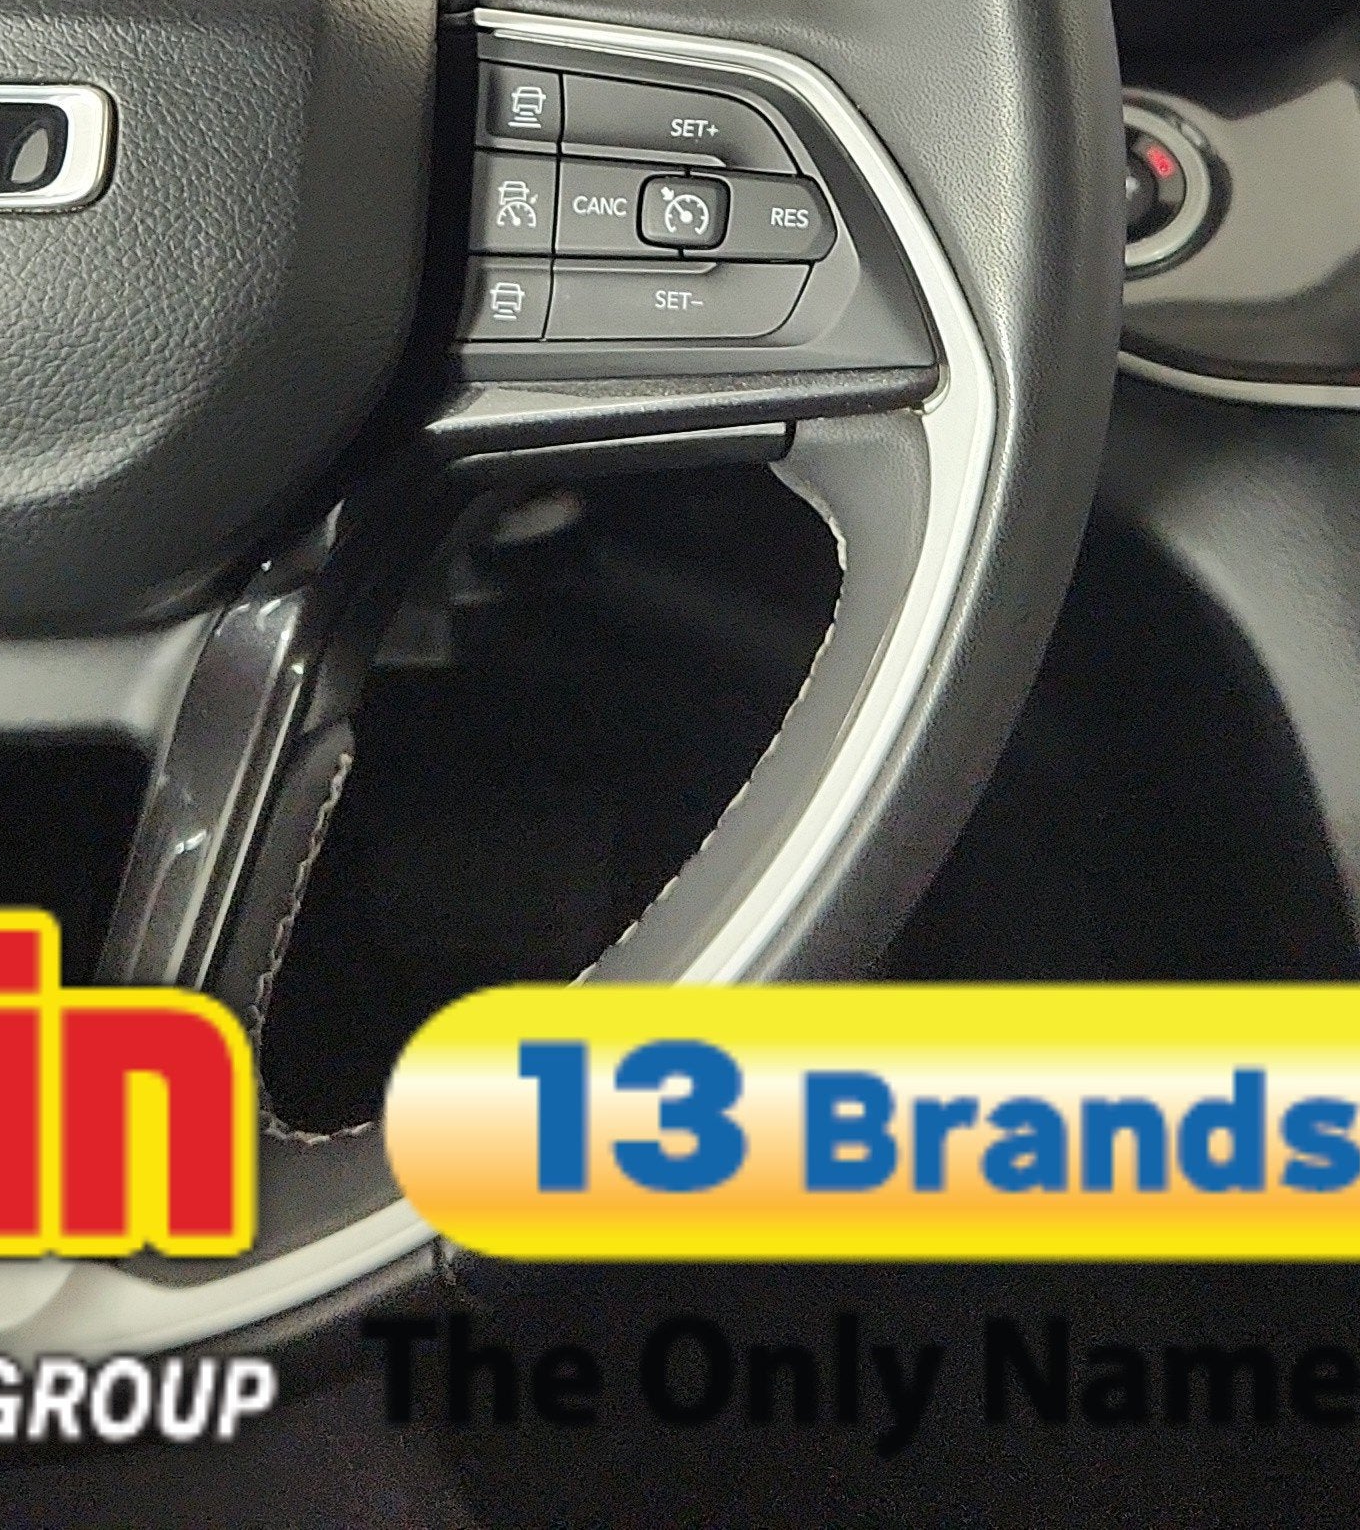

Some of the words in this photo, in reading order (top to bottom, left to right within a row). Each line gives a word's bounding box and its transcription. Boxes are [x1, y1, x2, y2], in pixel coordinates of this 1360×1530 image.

[670, 117, 719, 138] SET+
[572, 195, 628, 218] CANC
[770, 206, 810, 229] RES
